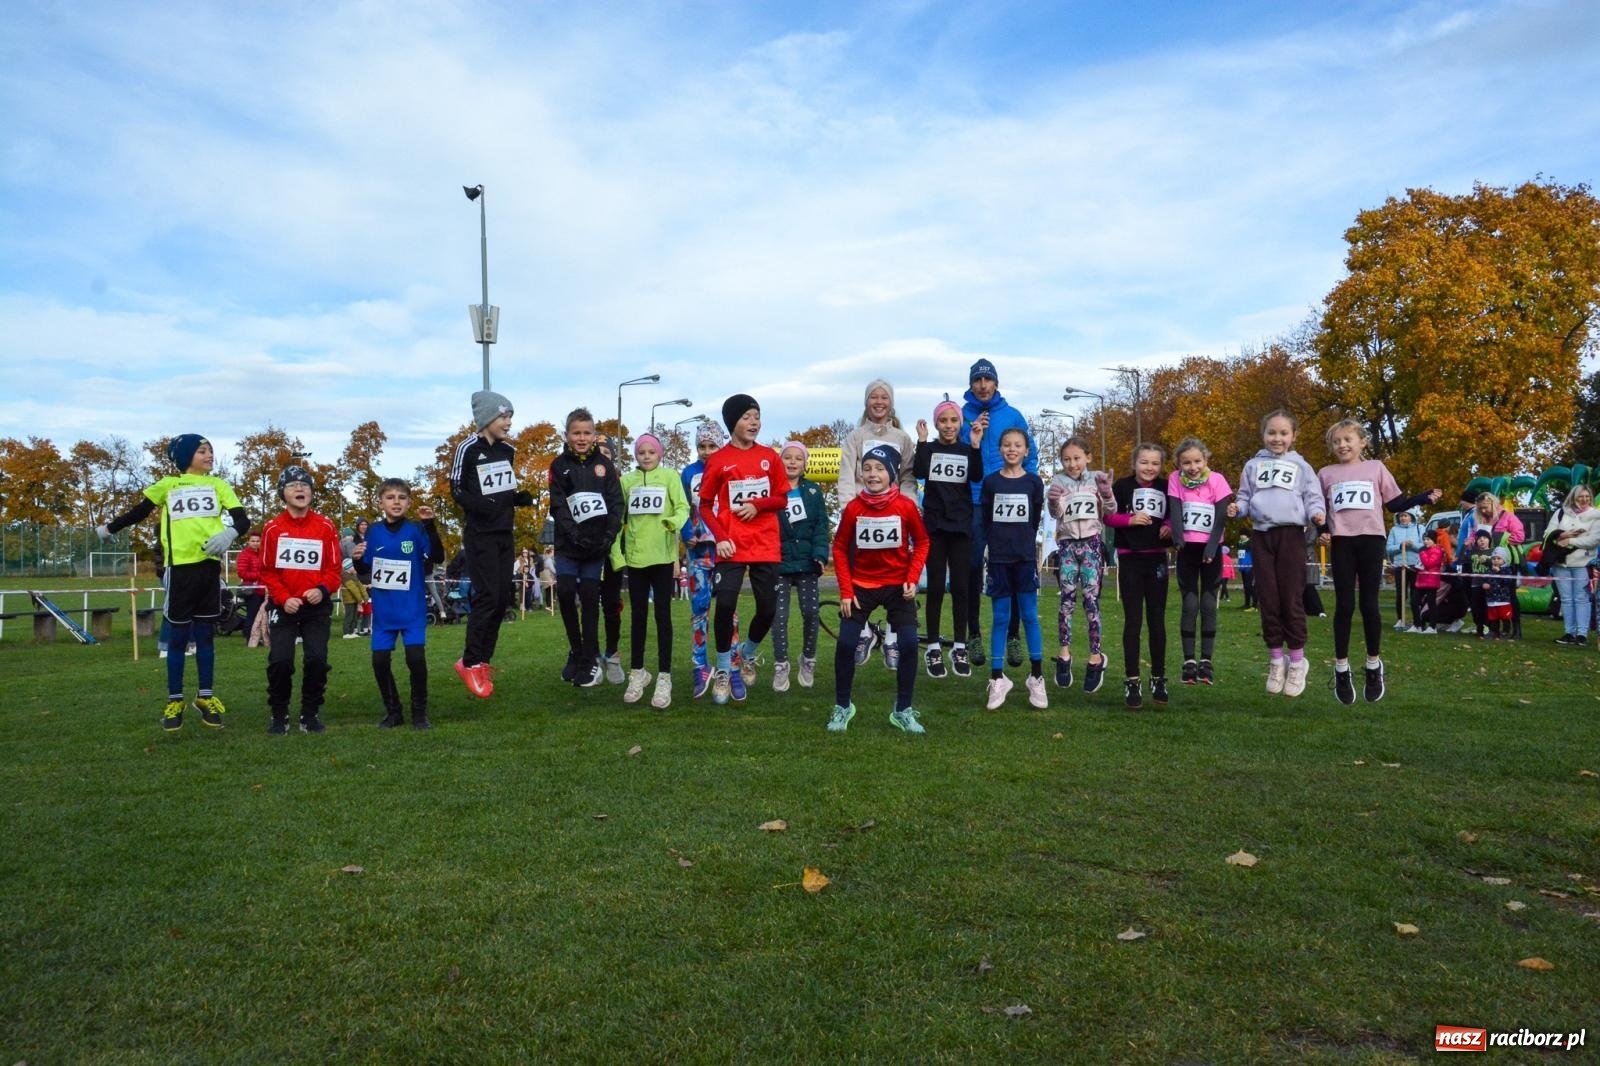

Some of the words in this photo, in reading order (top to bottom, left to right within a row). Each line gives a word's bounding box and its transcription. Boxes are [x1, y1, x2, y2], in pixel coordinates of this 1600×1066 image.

[932, 463, 966, 478] 465
[1258, 469, 1293, 484] 475
[483, 470, 513, 488] 477
[172, 496, 215, 513] 463
[631, 496, 663, 509] 480
[1334, 490, 1372, 505] 470
[573, 499, 604, 518] 462
[995, 503, 1027, 517] 478
[1065, 501, 1096, 517] 472
[1135, 498, 1163, 513] 551
[1182, 511, 1212, 528] 473
[858, 528, 900, 543] 464
[279, 548, 319, 565] 469
[373, 568, 408, 585] 474
